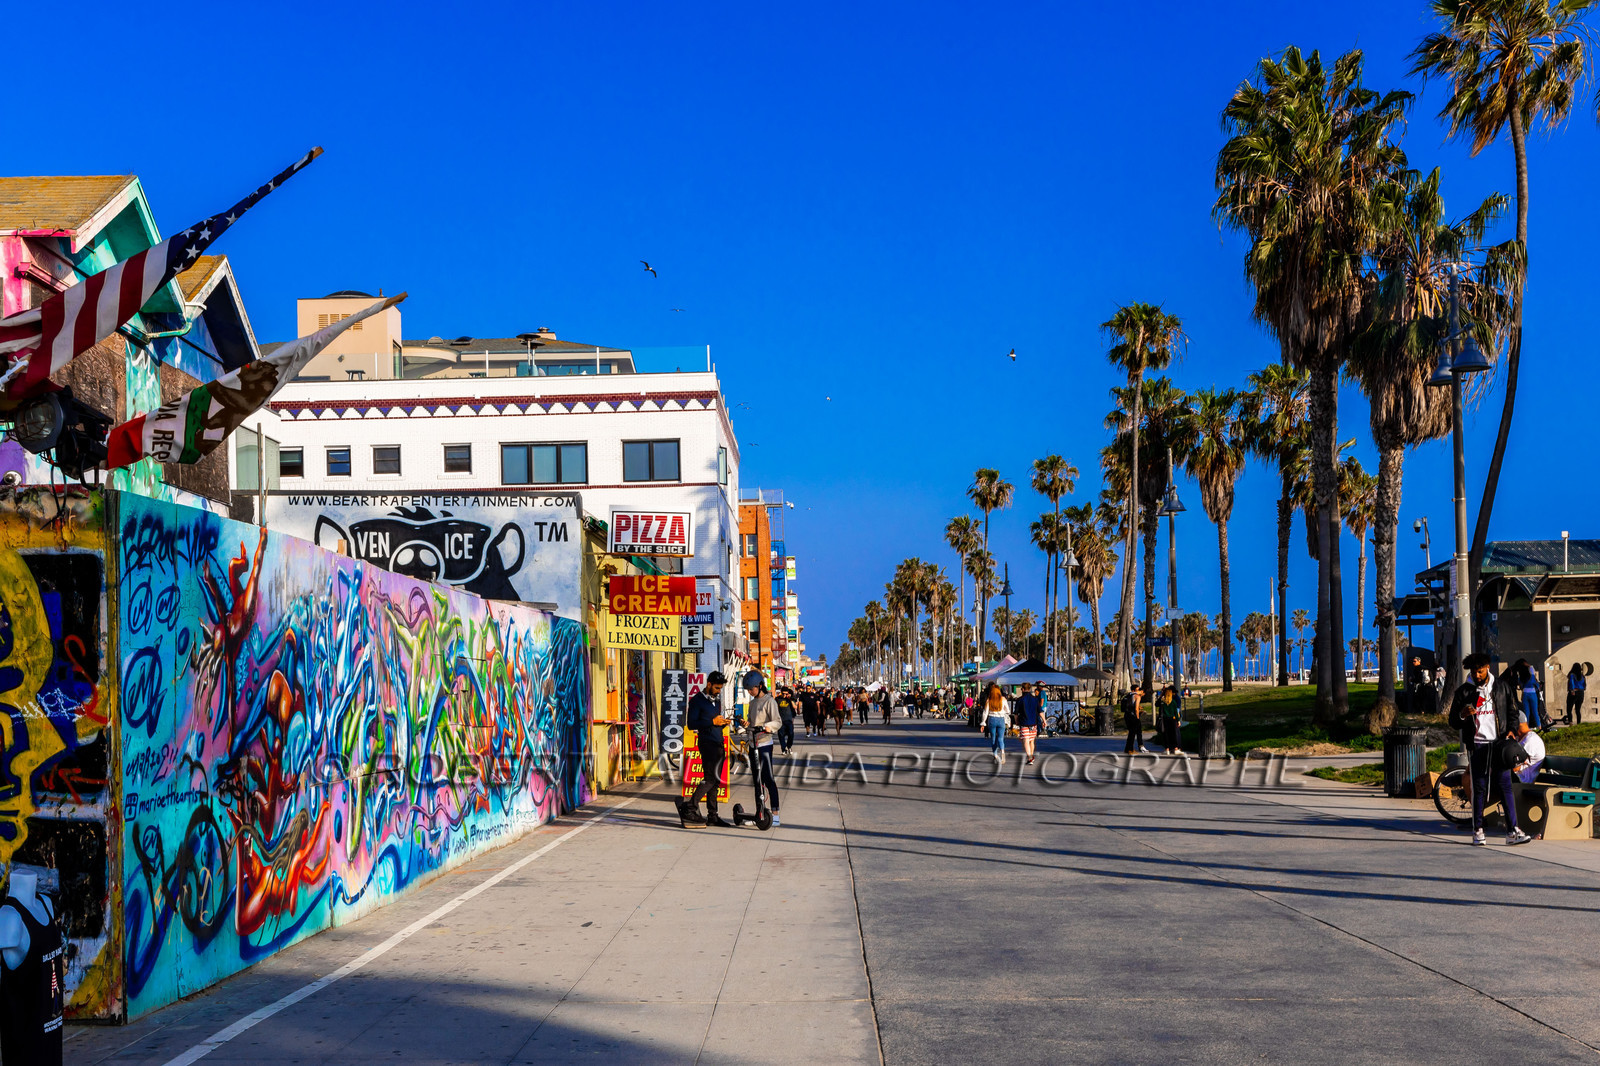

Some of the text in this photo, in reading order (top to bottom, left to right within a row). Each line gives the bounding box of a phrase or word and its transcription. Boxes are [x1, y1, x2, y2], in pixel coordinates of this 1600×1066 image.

[287, 495, 577, 508] WWW.BEARTRAPENTERTAINMENT.COM
[534, 521, 569, 543] TM
[615, 514, 686, 544] PIZZA
[617, 545, 684, 554] BY THE SLICE
[633, 575, 670, 593] ICE
[612, 594, 691, 613] CREAM
[615, 614, 670, 631] FROZEN
[694, 614, 712, 622] WINE
[608, 631, 678, 648] LEMONADE
[662, 670, 684, 752] TATTOO
